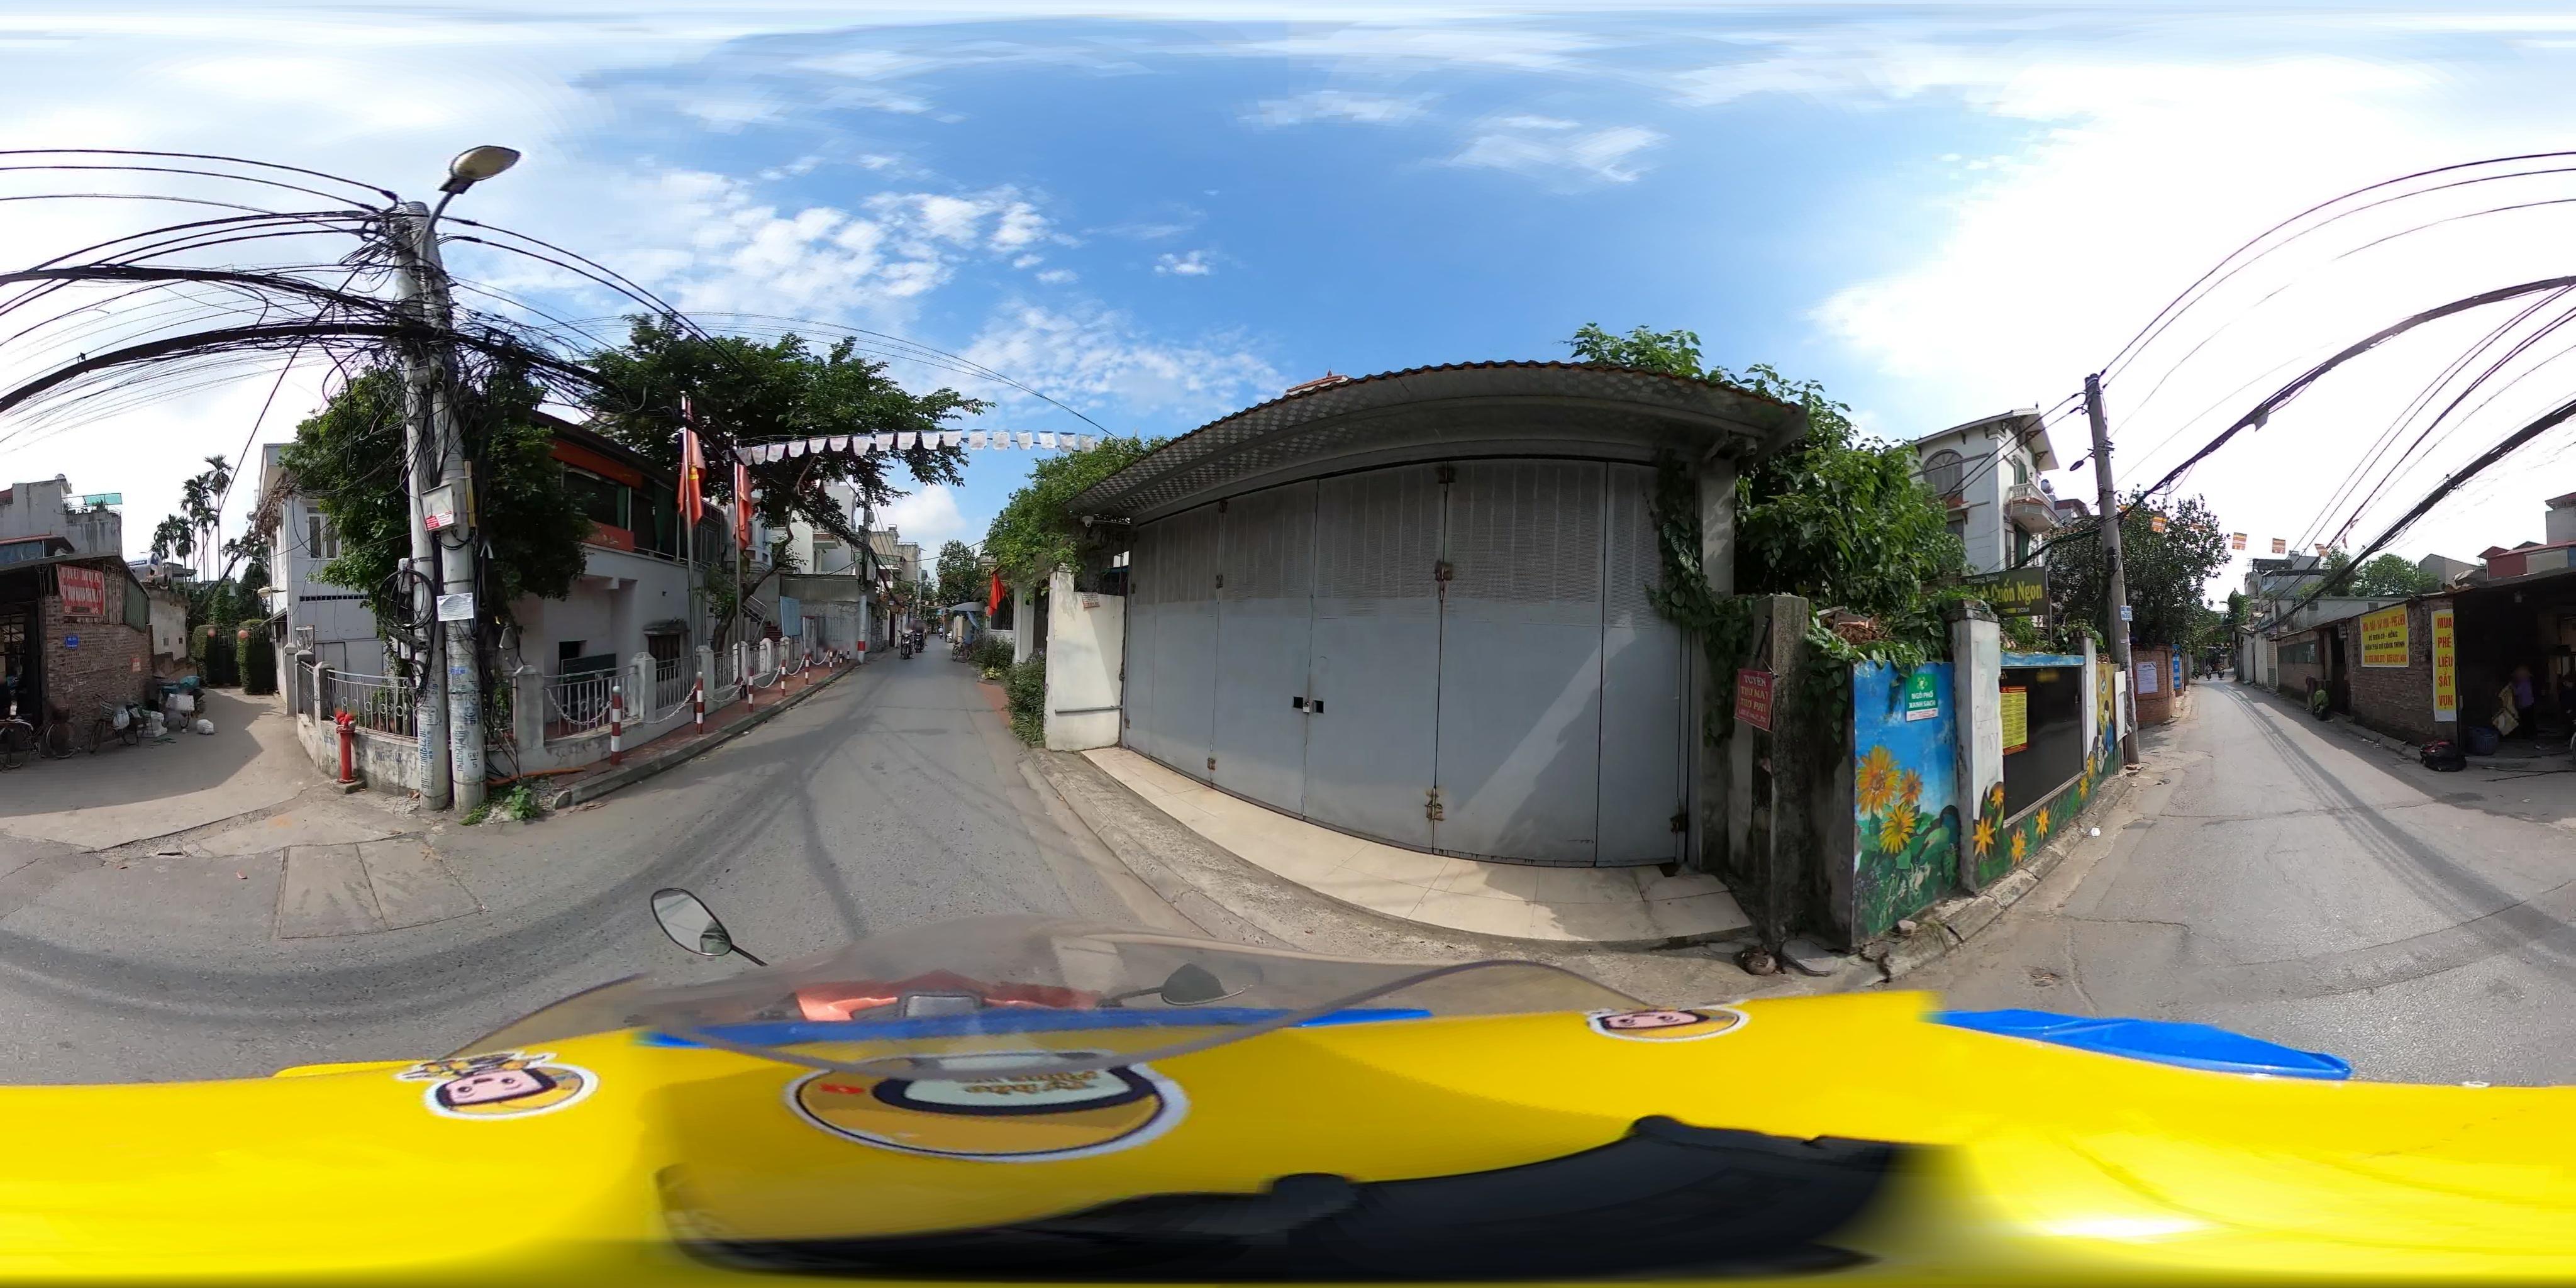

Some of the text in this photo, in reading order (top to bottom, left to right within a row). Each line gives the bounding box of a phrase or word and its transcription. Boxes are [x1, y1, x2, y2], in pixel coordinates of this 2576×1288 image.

[2017, 580, 2043, 605] Ngon
[2437, 618, 2454, 630] MUA
[2438, 633, 2452, 648] PHẾ
[2438, 654, 2453, 670] LIỆU
[2438, 672, 2451, 687] SẮT
[2439, 694, 2453, 709] VỤN
